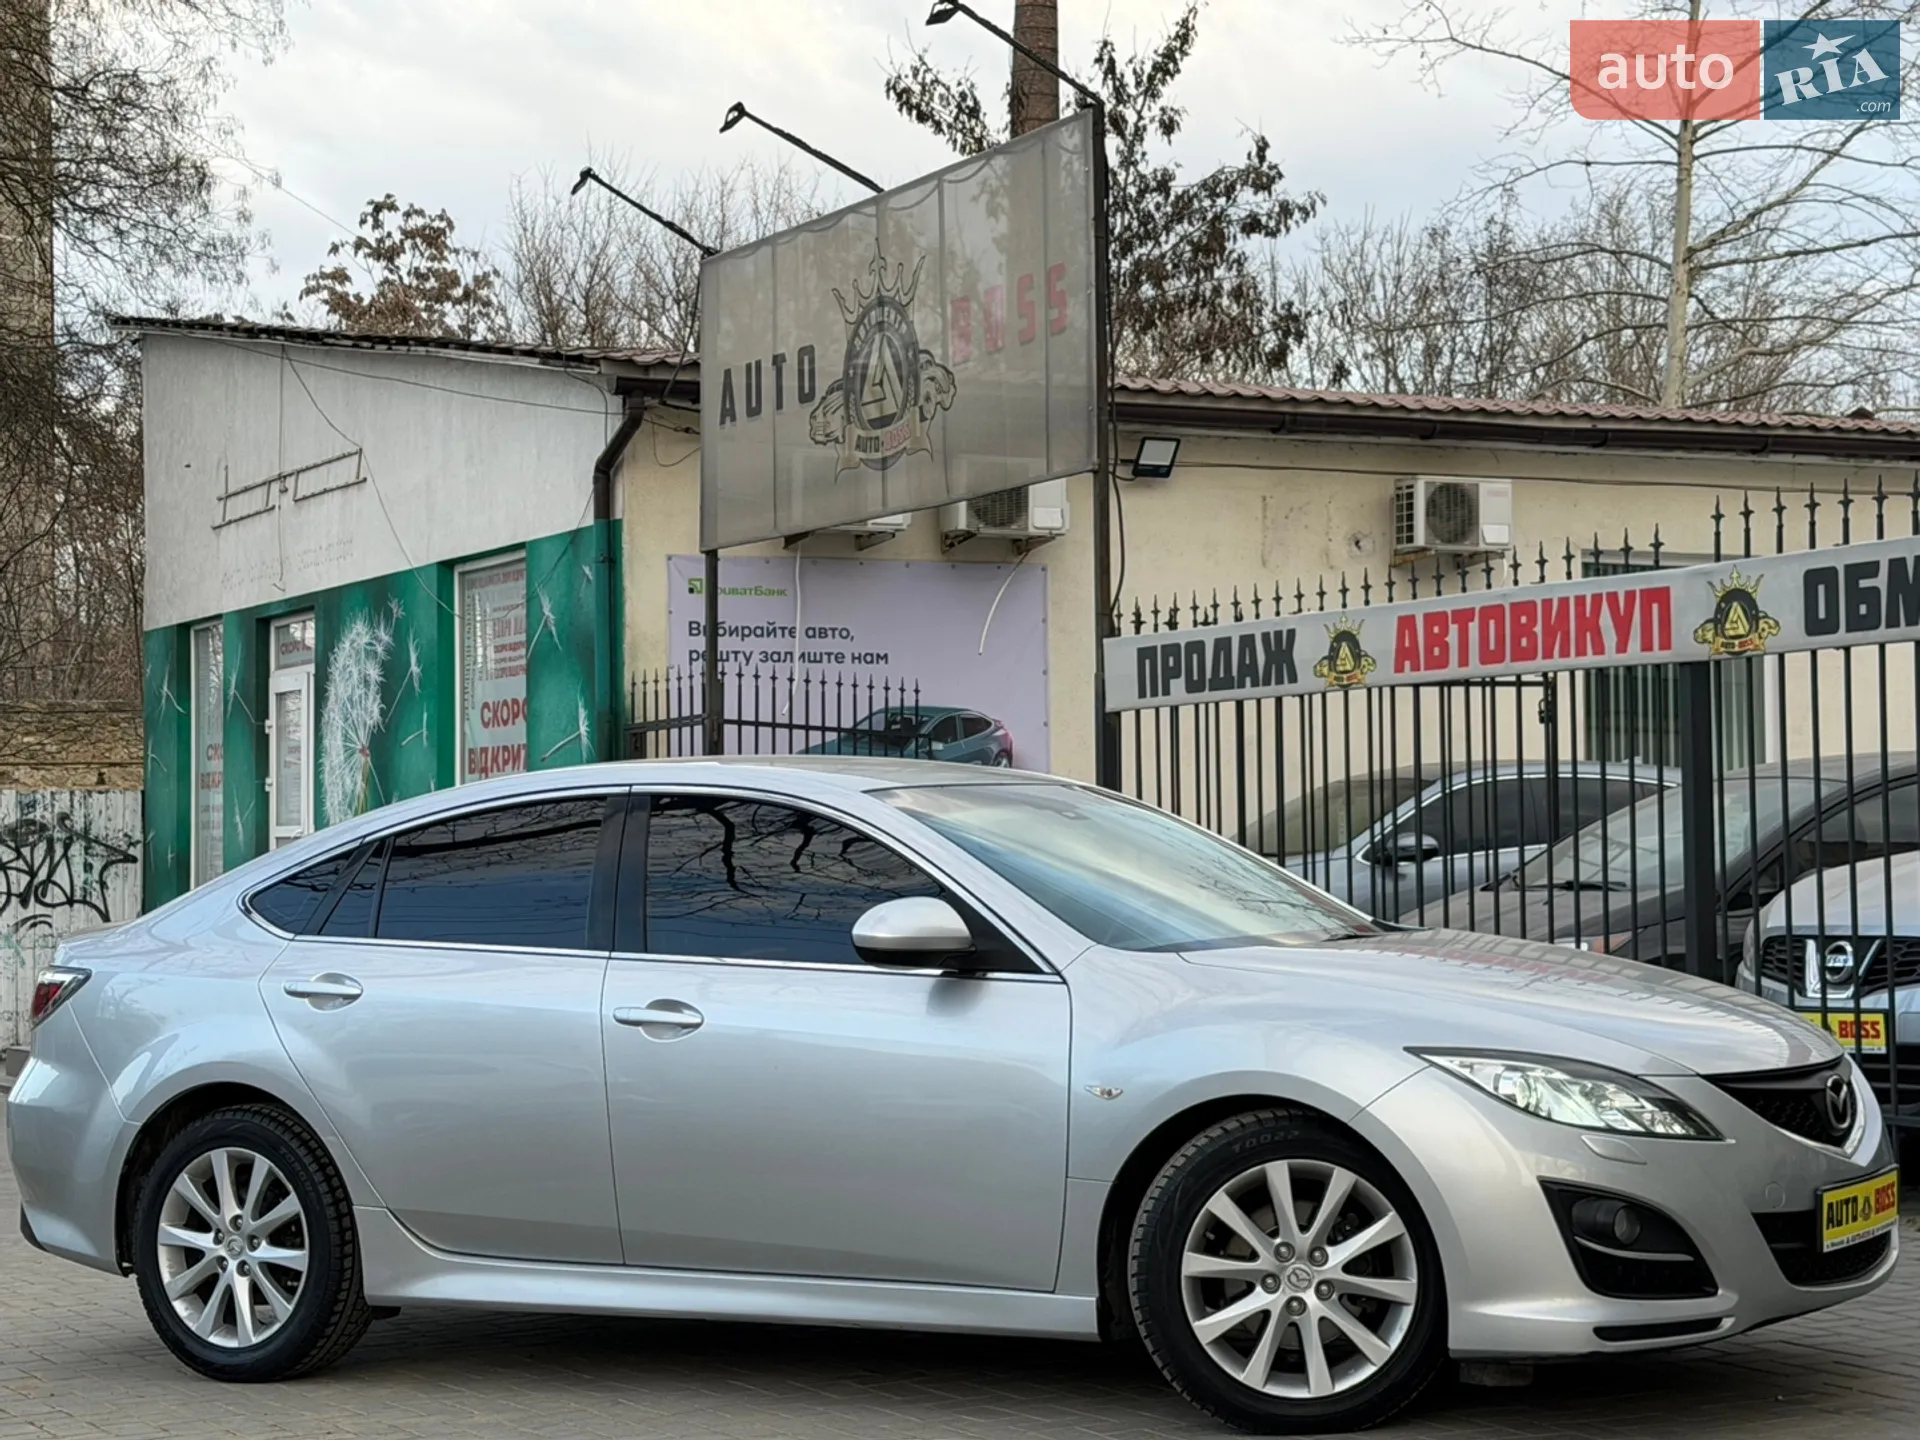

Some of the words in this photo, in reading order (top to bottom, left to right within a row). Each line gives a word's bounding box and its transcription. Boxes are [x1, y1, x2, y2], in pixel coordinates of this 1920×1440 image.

[719, 343, 816, 429] AUTO
[950, 261, 1068, 367] BOSS
[716, 584, 788, 597] риватБанк
[688, 620, 798, 642] Вбирайте
[804, 625, 855, 643] авто,
[1136, 628, 1298, 699] ПРОДАЖ
[1393, 585, 1672, 675] АВТОВИКУП
[851, 651, 889, 665] нам
[1826, 1195, 1859, 1230] AUTO
[1874, 1181, 1896, 1215] BOSS
